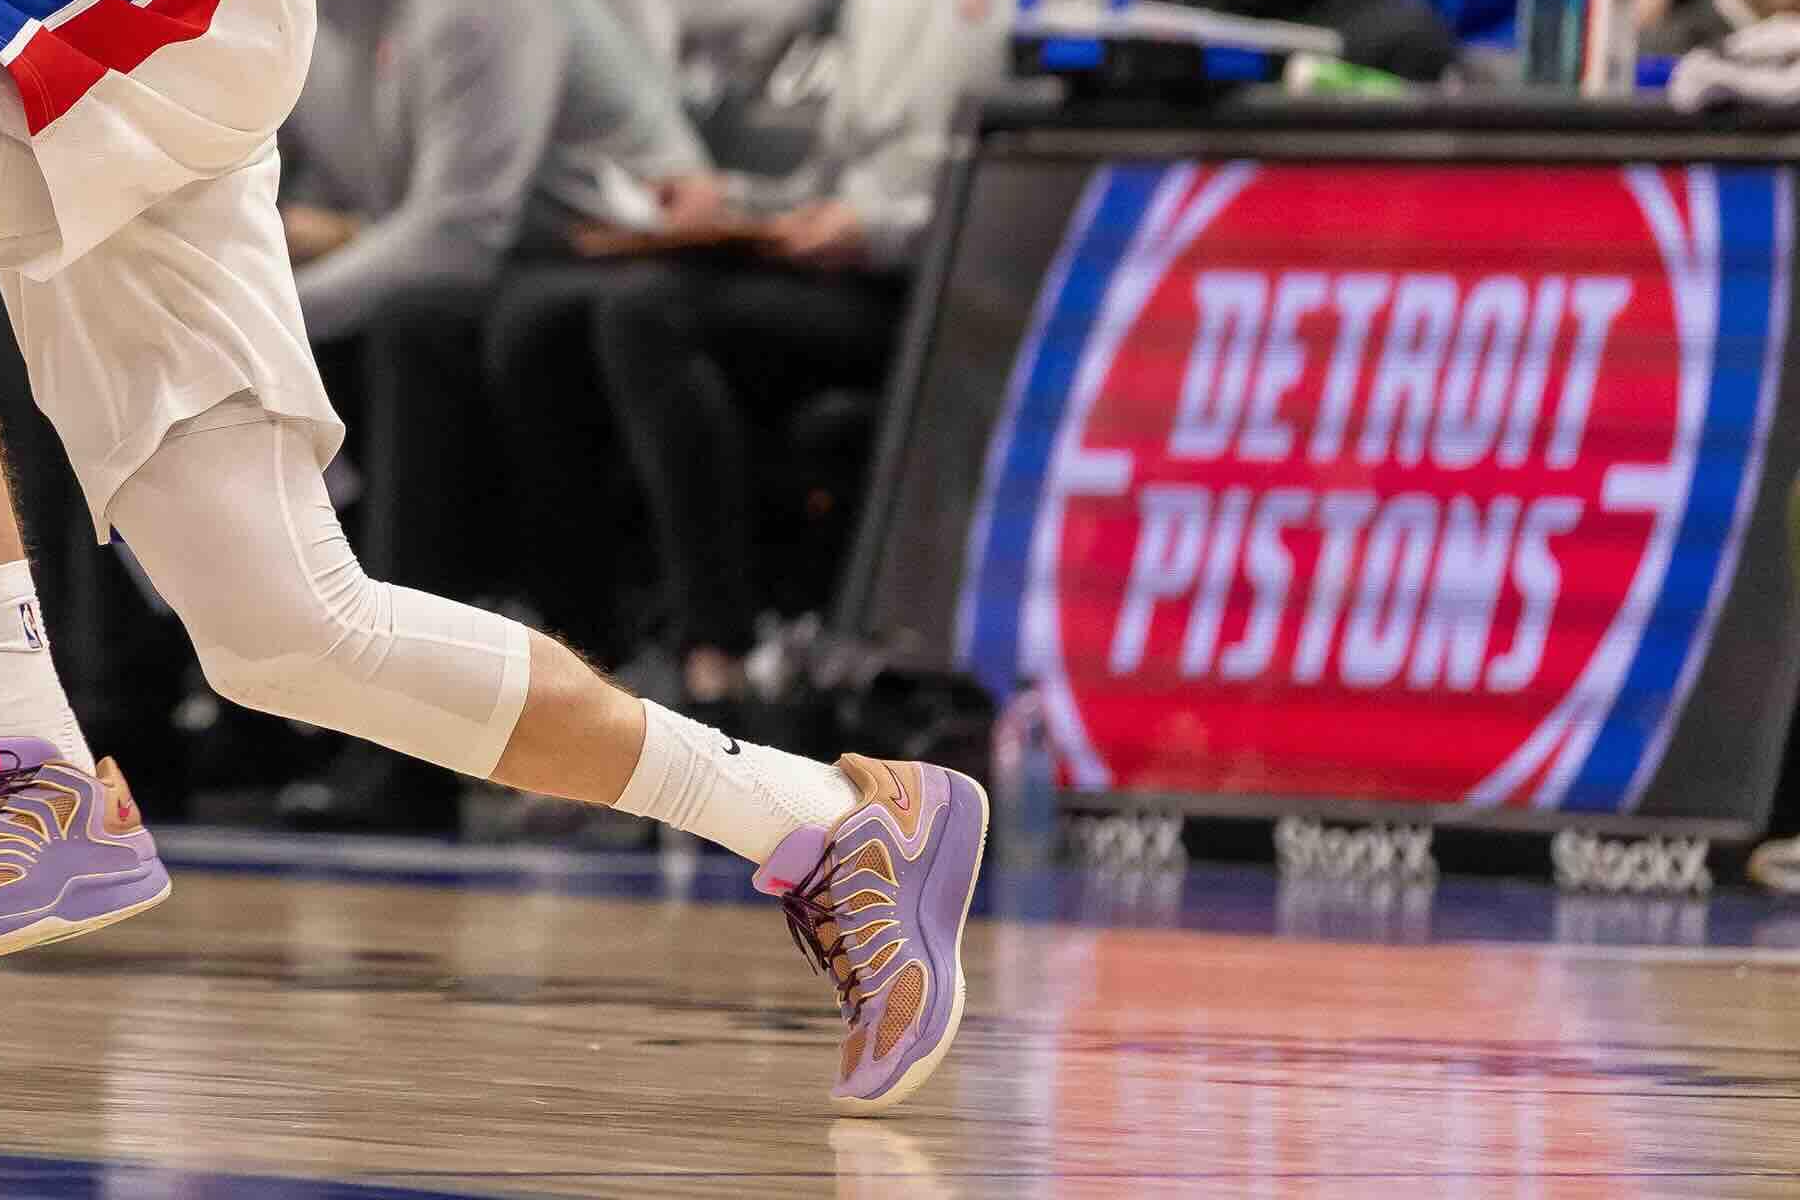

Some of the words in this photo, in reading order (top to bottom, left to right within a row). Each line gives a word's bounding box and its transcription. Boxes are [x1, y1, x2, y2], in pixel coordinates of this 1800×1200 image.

[1167, 271, 1633, 471] DETROIT
[1110, 487, 1584, 693] PISTONS
[1552, 827, 1711, 892] StockX
